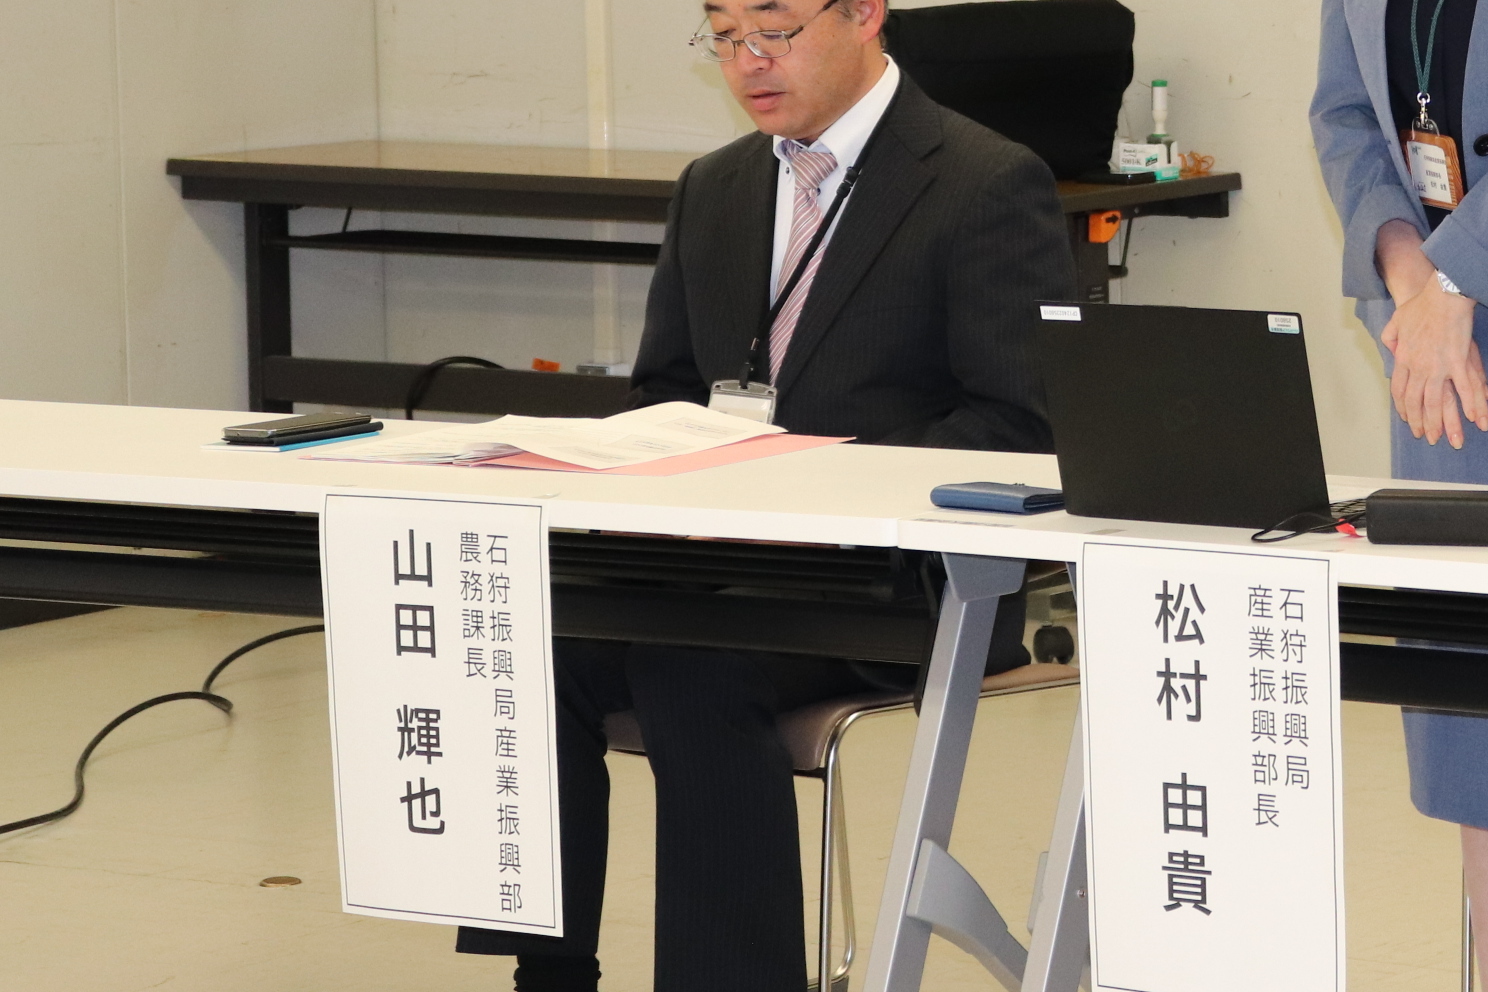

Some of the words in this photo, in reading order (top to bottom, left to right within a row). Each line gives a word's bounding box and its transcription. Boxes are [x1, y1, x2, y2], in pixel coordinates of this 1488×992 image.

[392, 528, 437, 658] 山田
[459, 531, 488, 680] 農務課長
[1154, 579, 1208, 724] 松村
[486, 533, 523, 914] 石狩振興局産業振興部
[1247, 583, 1281, 828] 産業振興部長
[1279, 587, 1311, 791] 石狩振興局
[396, 704, 446, 836] 輝也
[1161, 772, 1213, 917] 由貴
